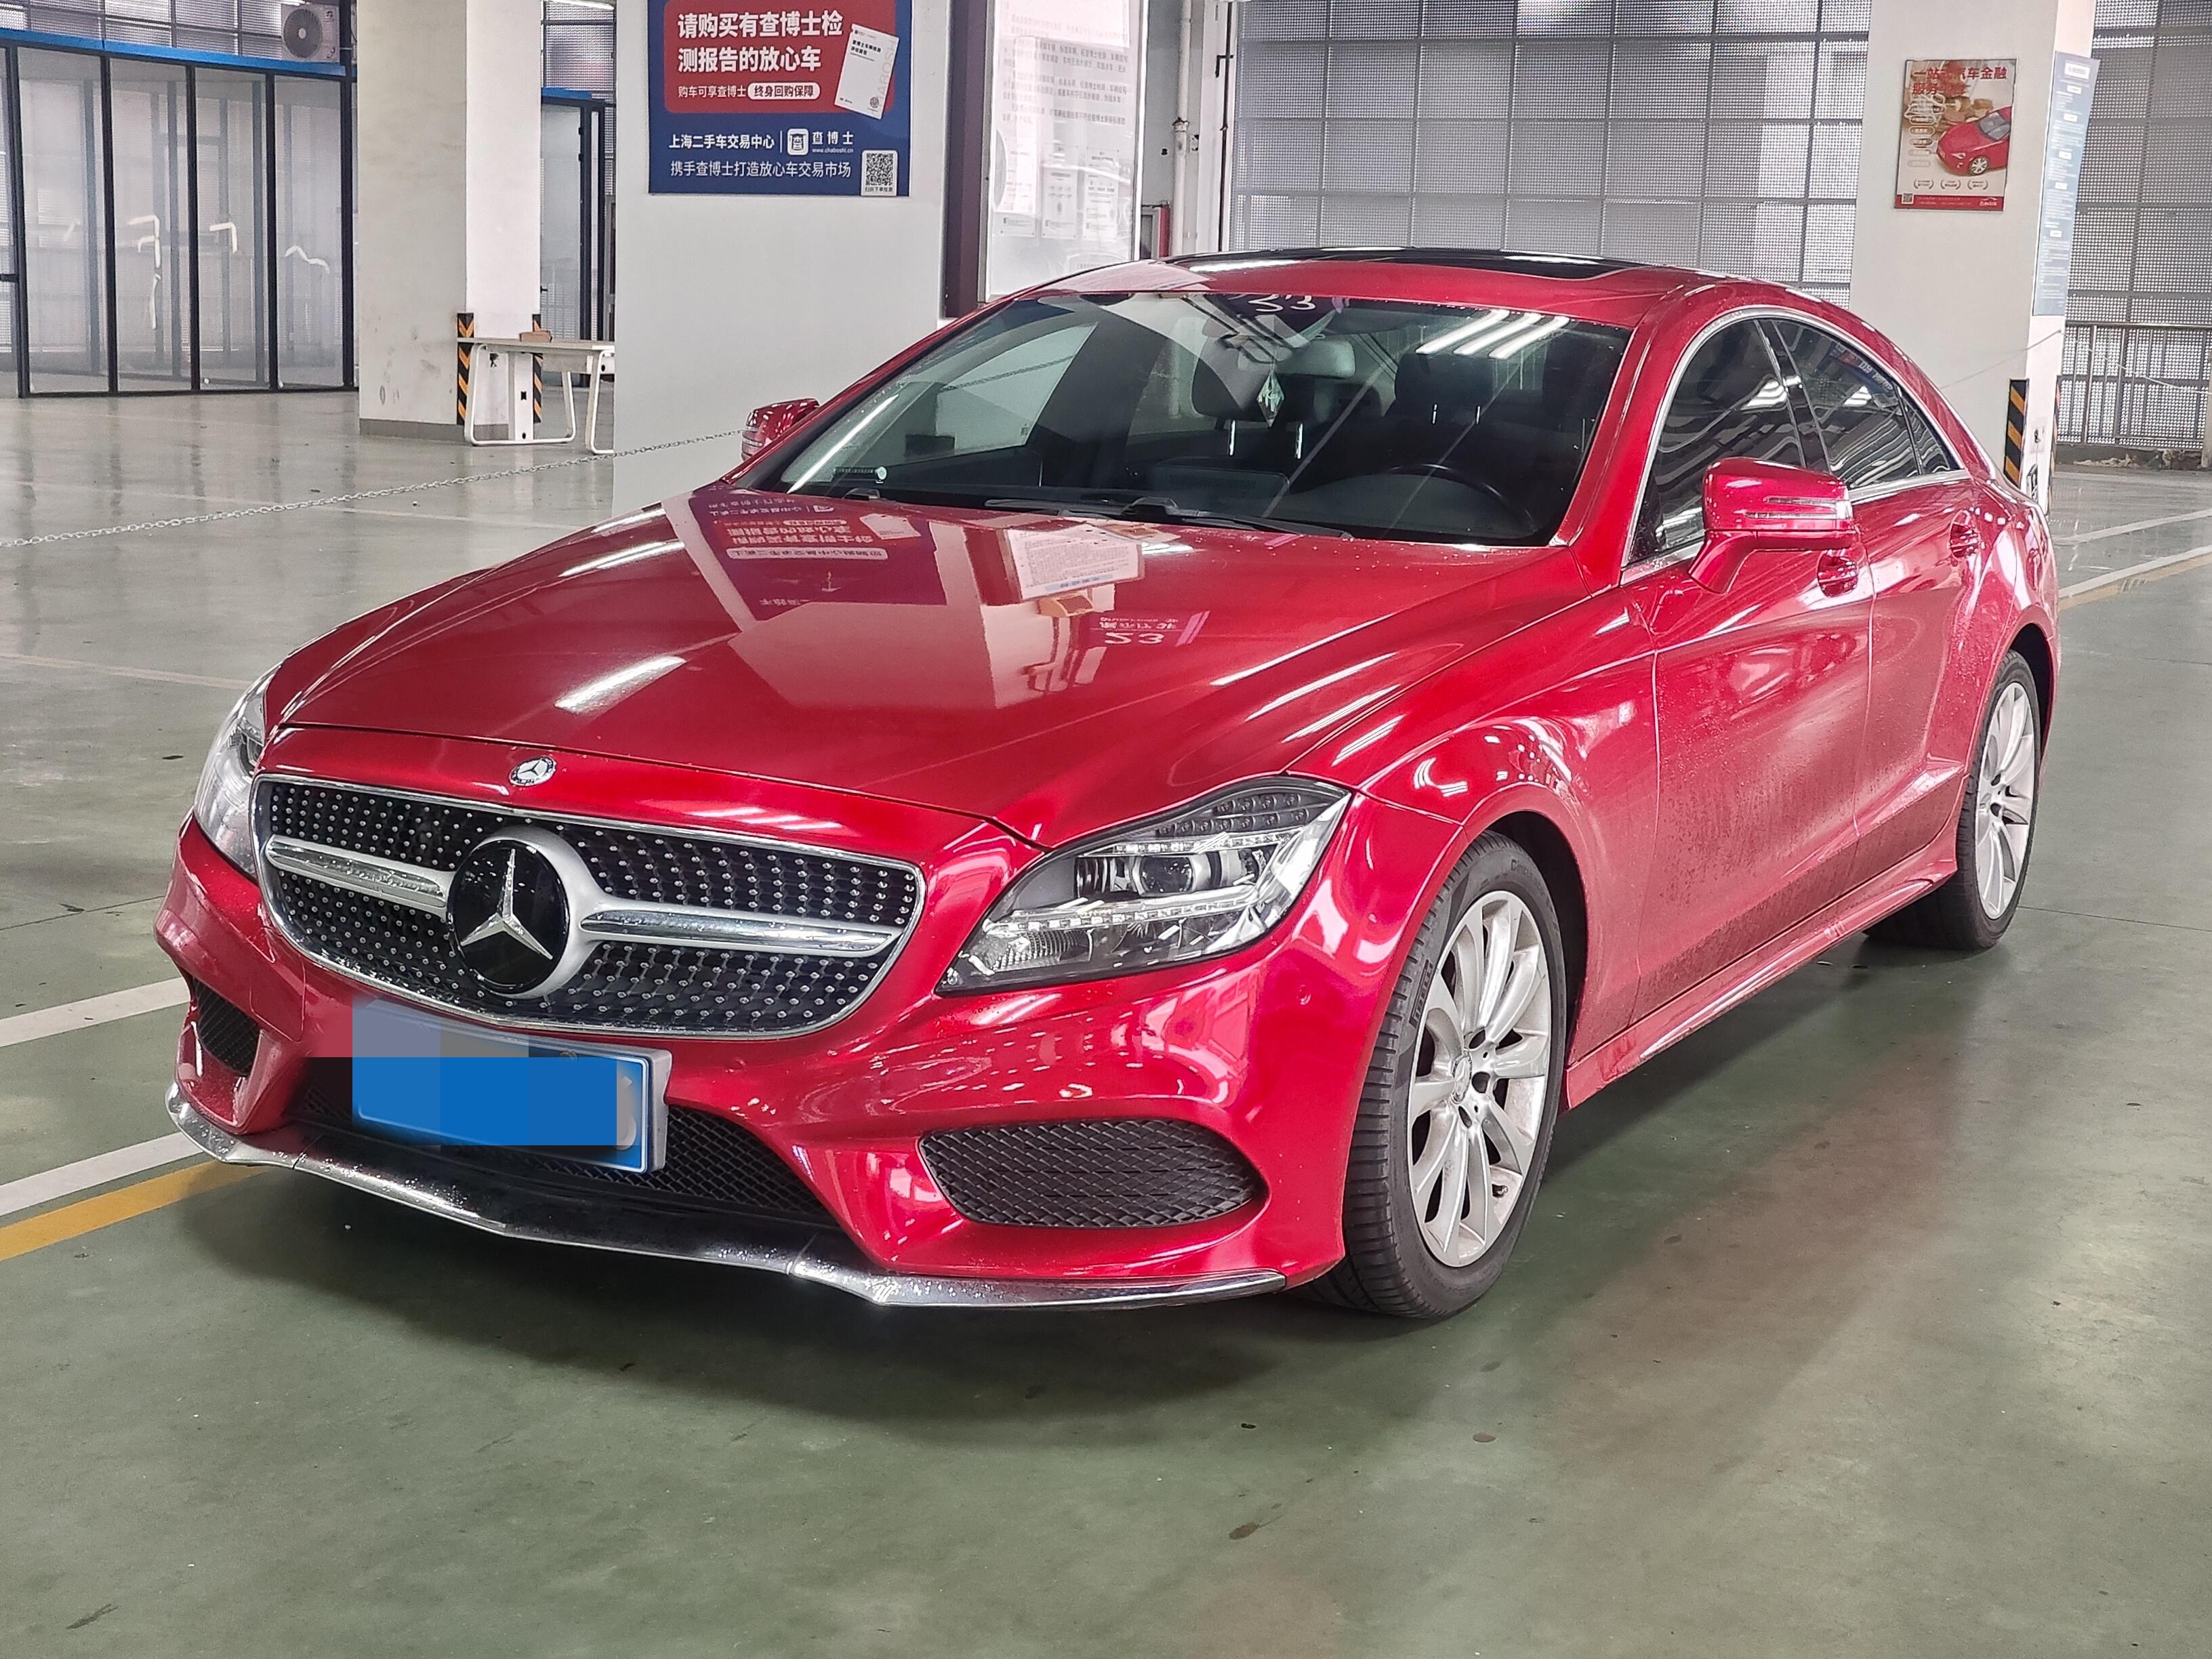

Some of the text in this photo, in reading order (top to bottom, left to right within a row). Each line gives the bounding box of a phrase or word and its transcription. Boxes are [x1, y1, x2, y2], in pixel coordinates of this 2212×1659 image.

[678, 9, 844, 39] 请购买有查博士检
[678, 45, 822, 73] 测报告的放心车
[678, 84, 814, 99] 购车可享查博士 终身回购保障
[669, 134, 775, 150] 上海二手车交易中心
[812, 131, 855, 145] 查博士
[670, 160, 852, 178] 携手查博士打造放心车交易市场
